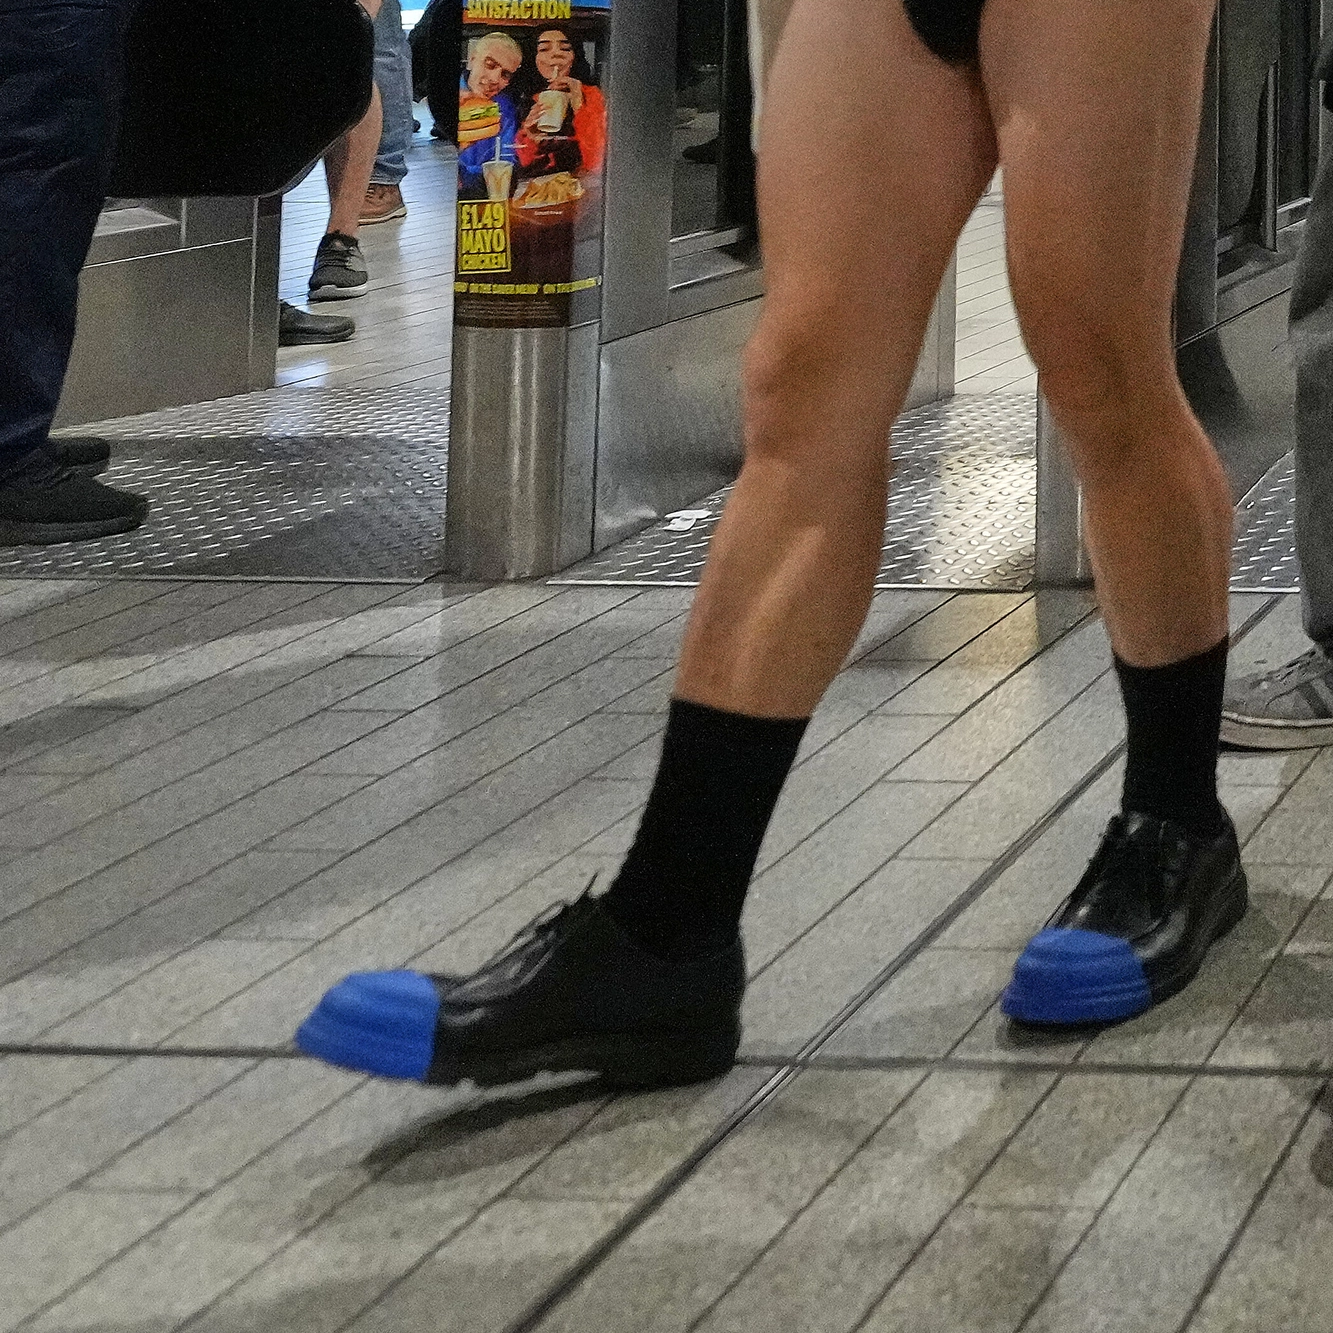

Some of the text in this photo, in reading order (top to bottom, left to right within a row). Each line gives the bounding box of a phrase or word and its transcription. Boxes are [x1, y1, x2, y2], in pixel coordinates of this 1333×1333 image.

[467, 0, 571, 19] SATISFACTION
[461, 203, 505, 229] £1.49
[461, 228, 506, 254] MAYO
